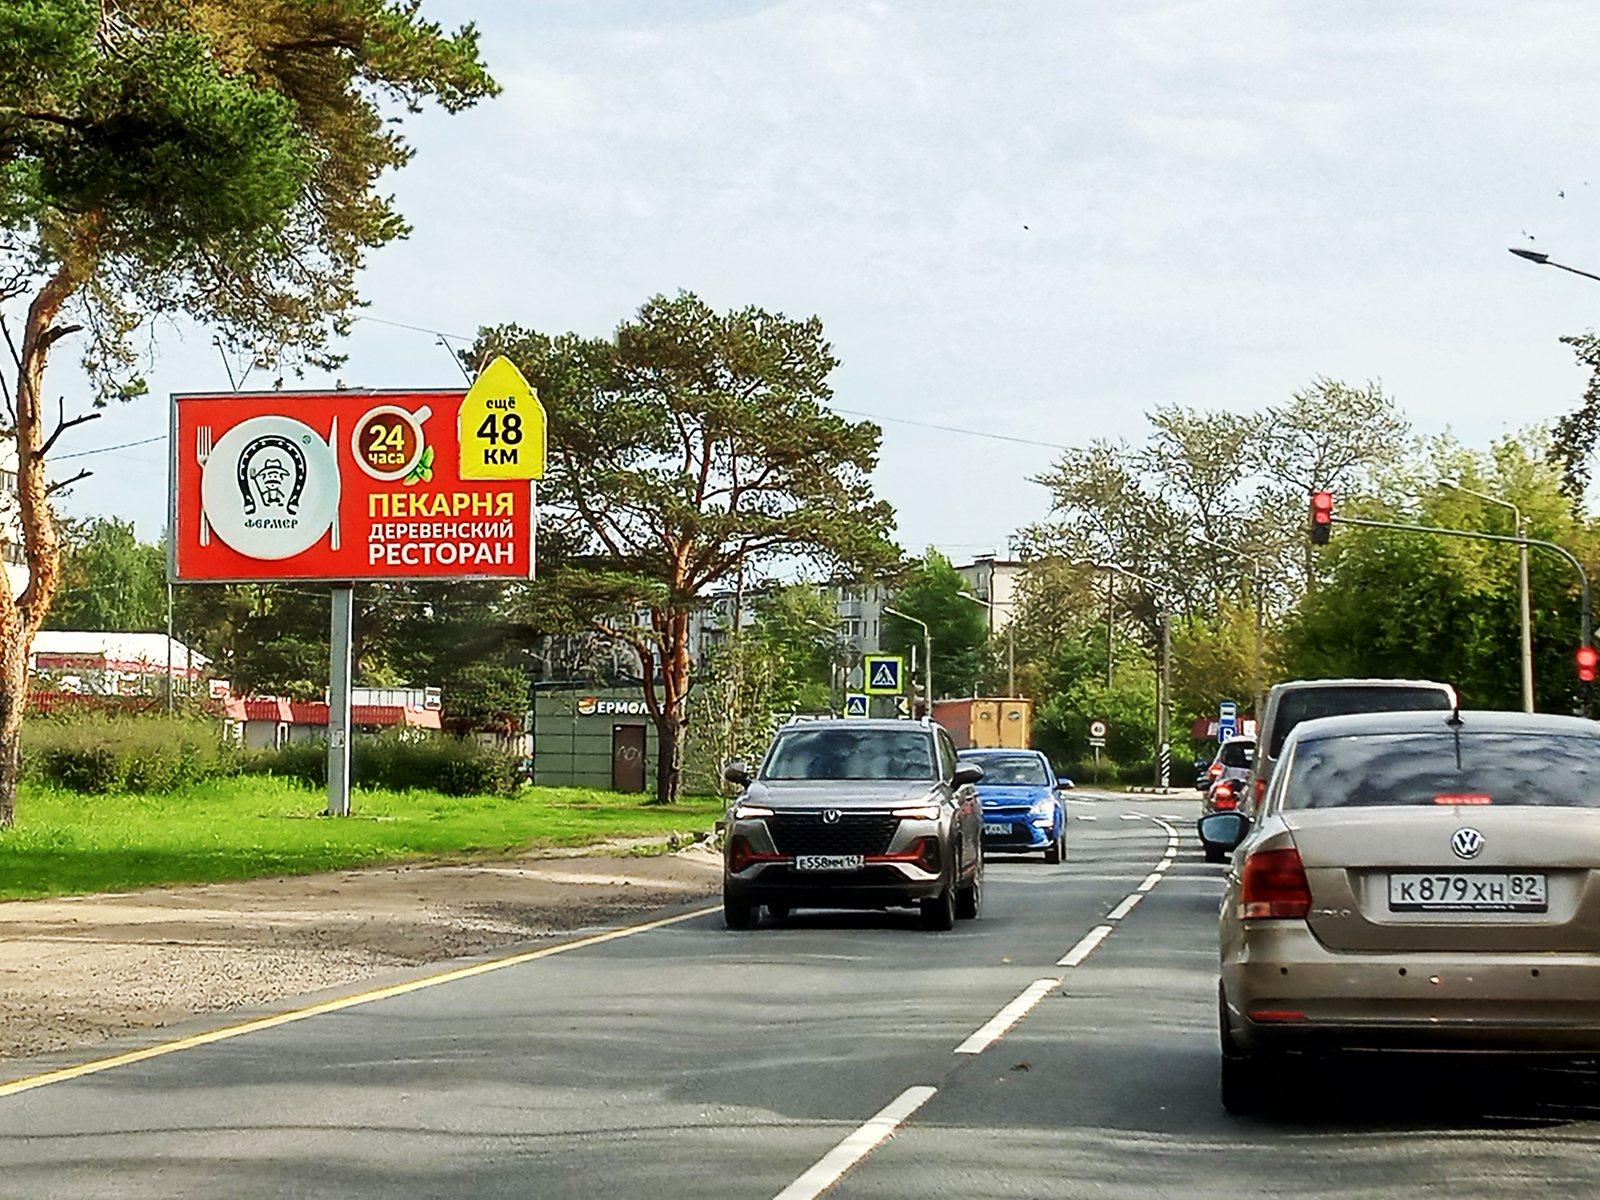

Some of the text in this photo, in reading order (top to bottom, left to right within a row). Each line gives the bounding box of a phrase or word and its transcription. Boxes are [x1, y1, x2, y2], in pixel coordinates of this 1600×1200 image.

[486, 396, 516, 411] ещё
[369, 425, 405, 451] 24
[477, 414, 523, 445] 48
[368, 453, 405, 464] часа
[368, 493, 514, 517] ПЕКАРНЯ
[368, 519, 514, 542] ДЕРЕВЕНСКИЙ
[368, 542, 514, 565] РЕСТОРАН
[1511, 876, 1537, 895] 82
